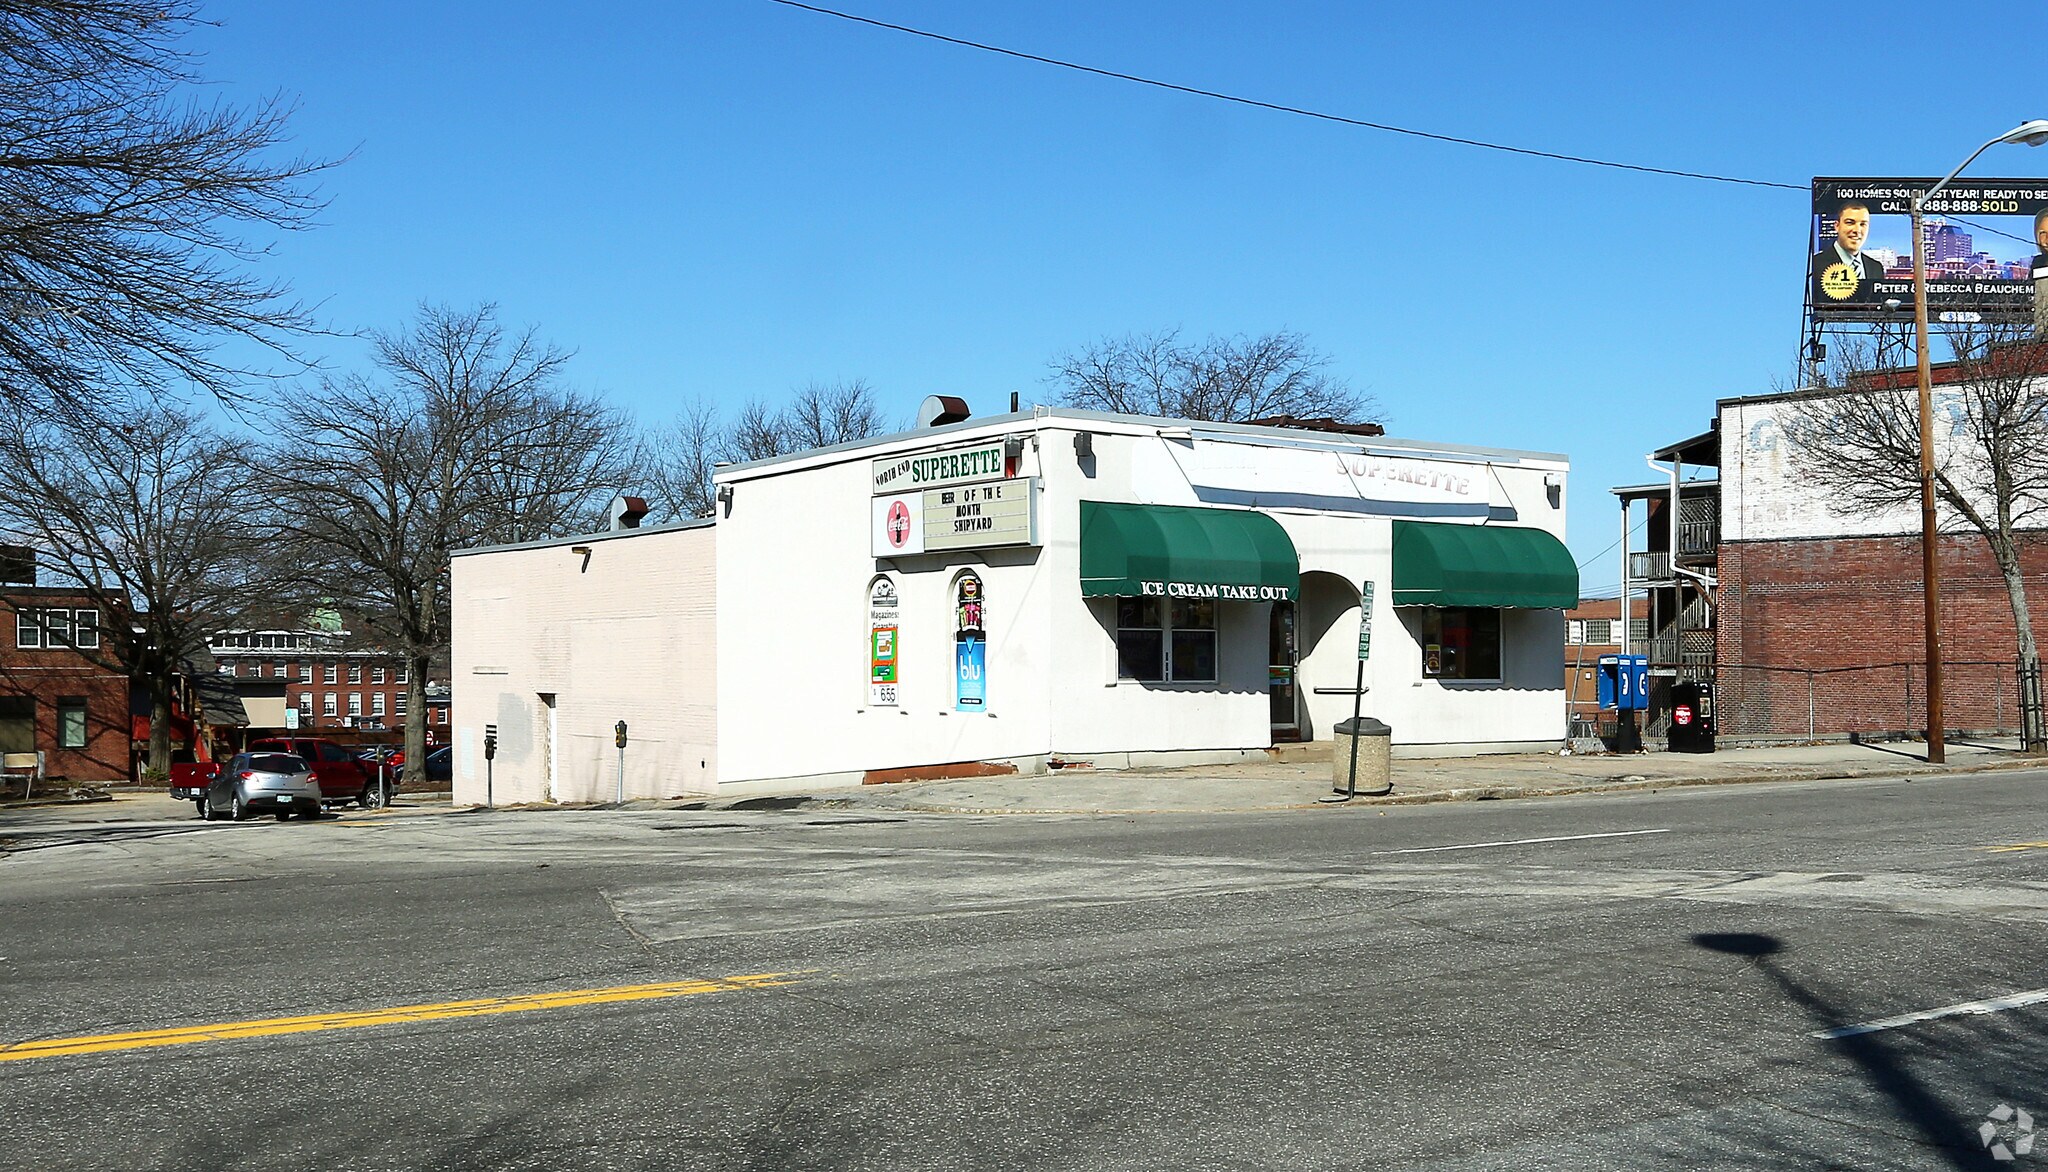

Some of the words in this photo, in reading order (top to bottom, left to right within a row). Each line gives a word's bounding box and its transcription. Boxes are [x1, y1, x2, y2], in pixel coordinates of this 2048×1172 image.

[1836, 188, 1854, 199] 100
[1855, 188, 1892, 199] HOMES
[1893, 188, 1920, 199] SOL
[1949, 188, 1980, 199] YEAR!
[1983, 189, 2018, 199] READY
[2018, 189, 2033, 199] TO
[1830, 268, 1850, 281] #1
[1873, 282, 1909, 293] PETER
[1923, 283, 1973, 293] REBECCA
[1974, 283, 2035, 294] BEAUCHEM
[875, 465, 897, 487] NORTH
[898, 459, 911, 478] END
[911, 448, 1001, 483] SUPERETTE
[1336, 455, 1470, 496] SUPERETTE
[941, 491, 955, 505] BEER
[964, 488, 976, 502] OF
[955, 503, 981, 518] MONTH
[954, 517, 993, 533] SHIPYARD
[1140, 581, 1165, 596] ICE
[1167, 582, 1219, 598] CREAM
[1220, 584, 1258, 600] TAKE
[1260, 586, 1289, 601] OUT
[959, 655, 981, 681] blu
